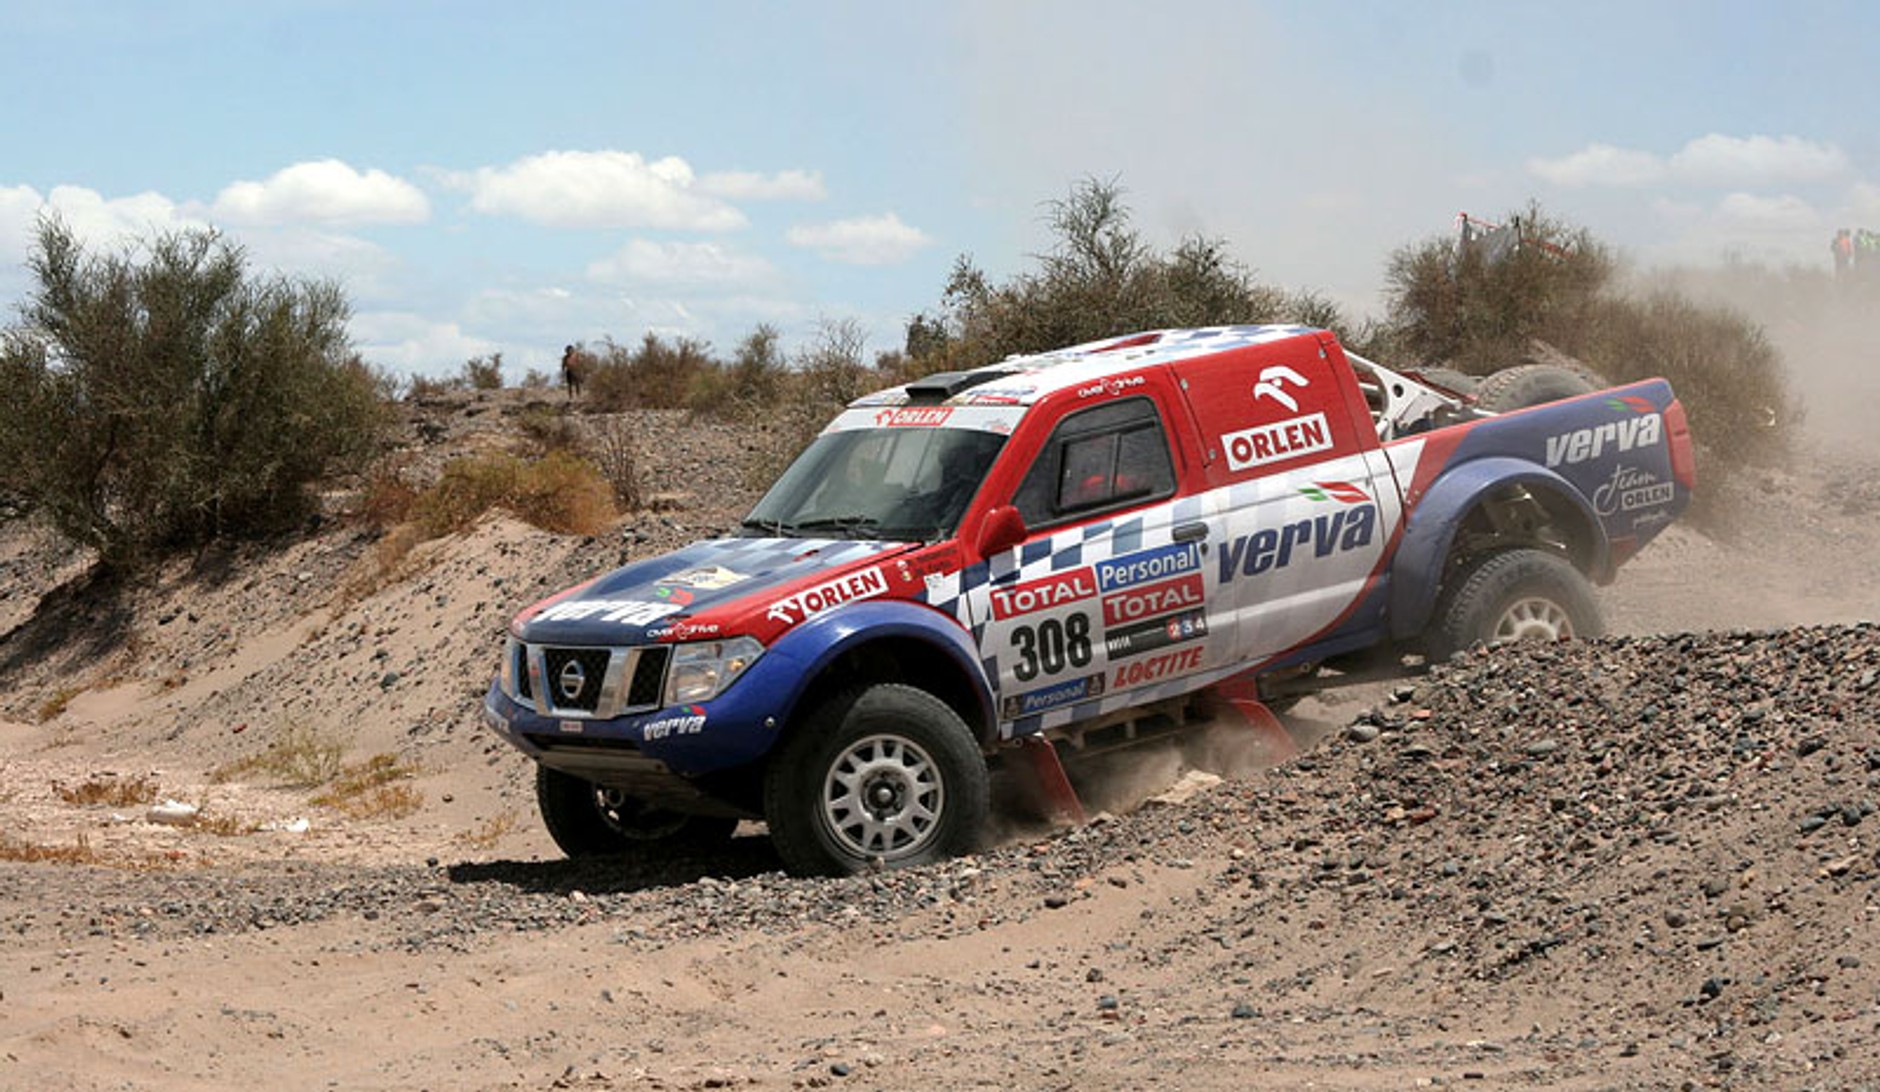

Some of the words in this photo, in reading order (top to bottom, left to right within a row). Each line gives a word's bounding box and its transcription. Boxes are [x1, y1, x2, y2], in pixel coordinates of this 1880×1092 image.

[1231, 419, 1325, 463] ORLEN
[1545, 412, 1661, 469] verva
[1624, 485, 1671, 507] ORLEN
[1218, 503, 1376, 584] verva
[1102, 546, 1196, 589] Personal
[805, 571, 882, 613] ORLEN
[994, 578, 1093, 615] TOTAL
[1106, 583, 1200, 621] TOTAL
[1010, 611, 1092, 682] 308
[1113, 645, 1205, 689] LOCTITE
[1024, 680, 1085, 709] Personal
[643, 714, 707, 741] verva
